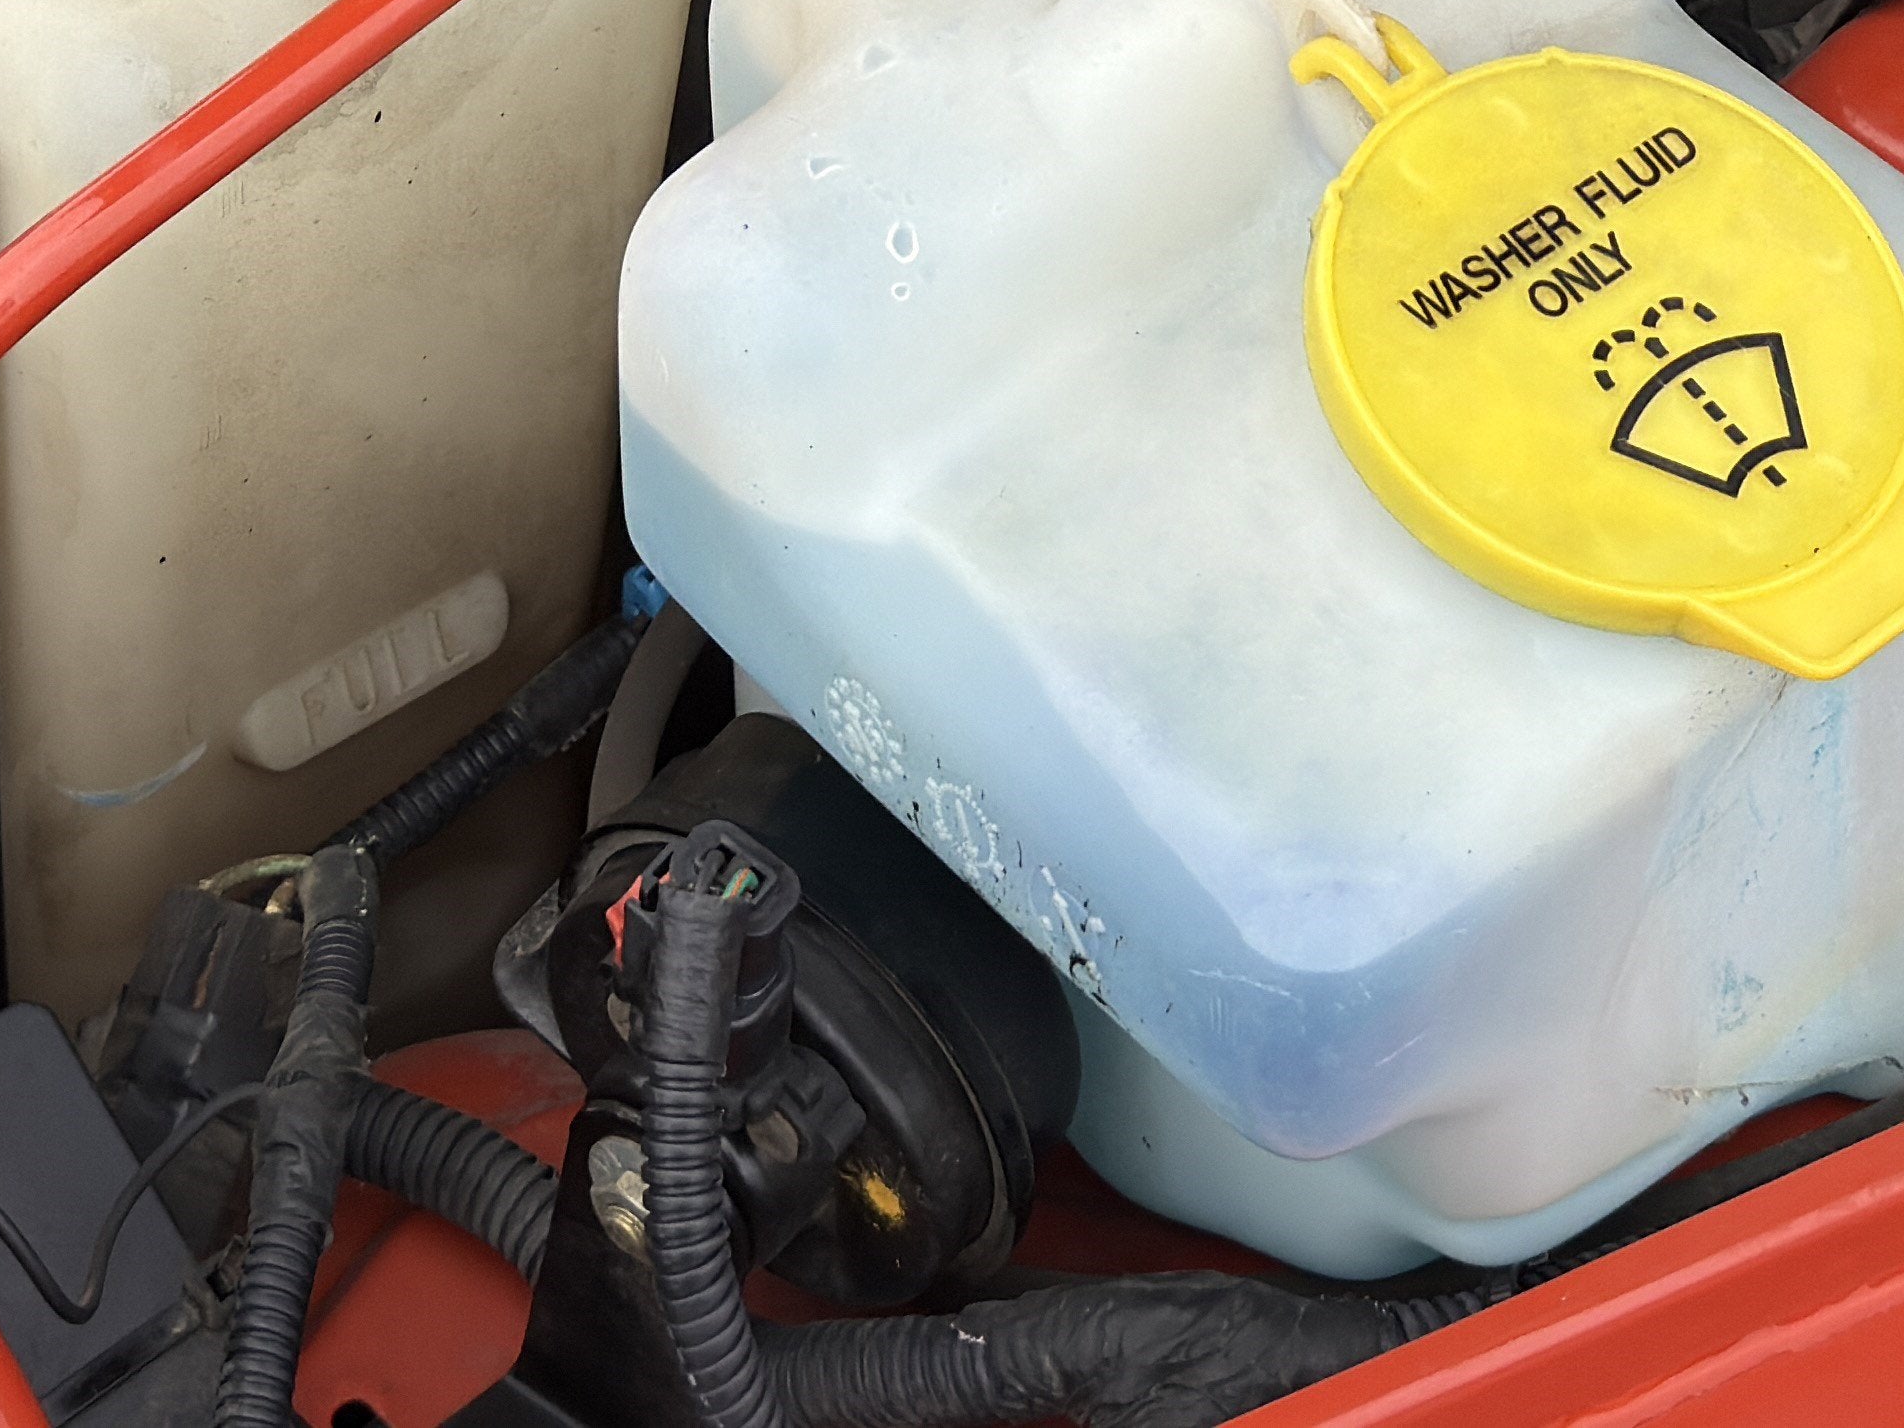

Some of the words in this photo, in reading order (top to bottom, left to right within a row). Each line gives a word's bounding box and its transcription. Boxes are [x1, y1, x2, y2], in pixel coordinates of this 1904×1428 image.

[1398, 203, 1583, 331] WASHER
[1574, 125, 1699, 220] FLUID
[1526, 229, 1635, 320] ONLY
[299, 609, 471, 746] FULL
